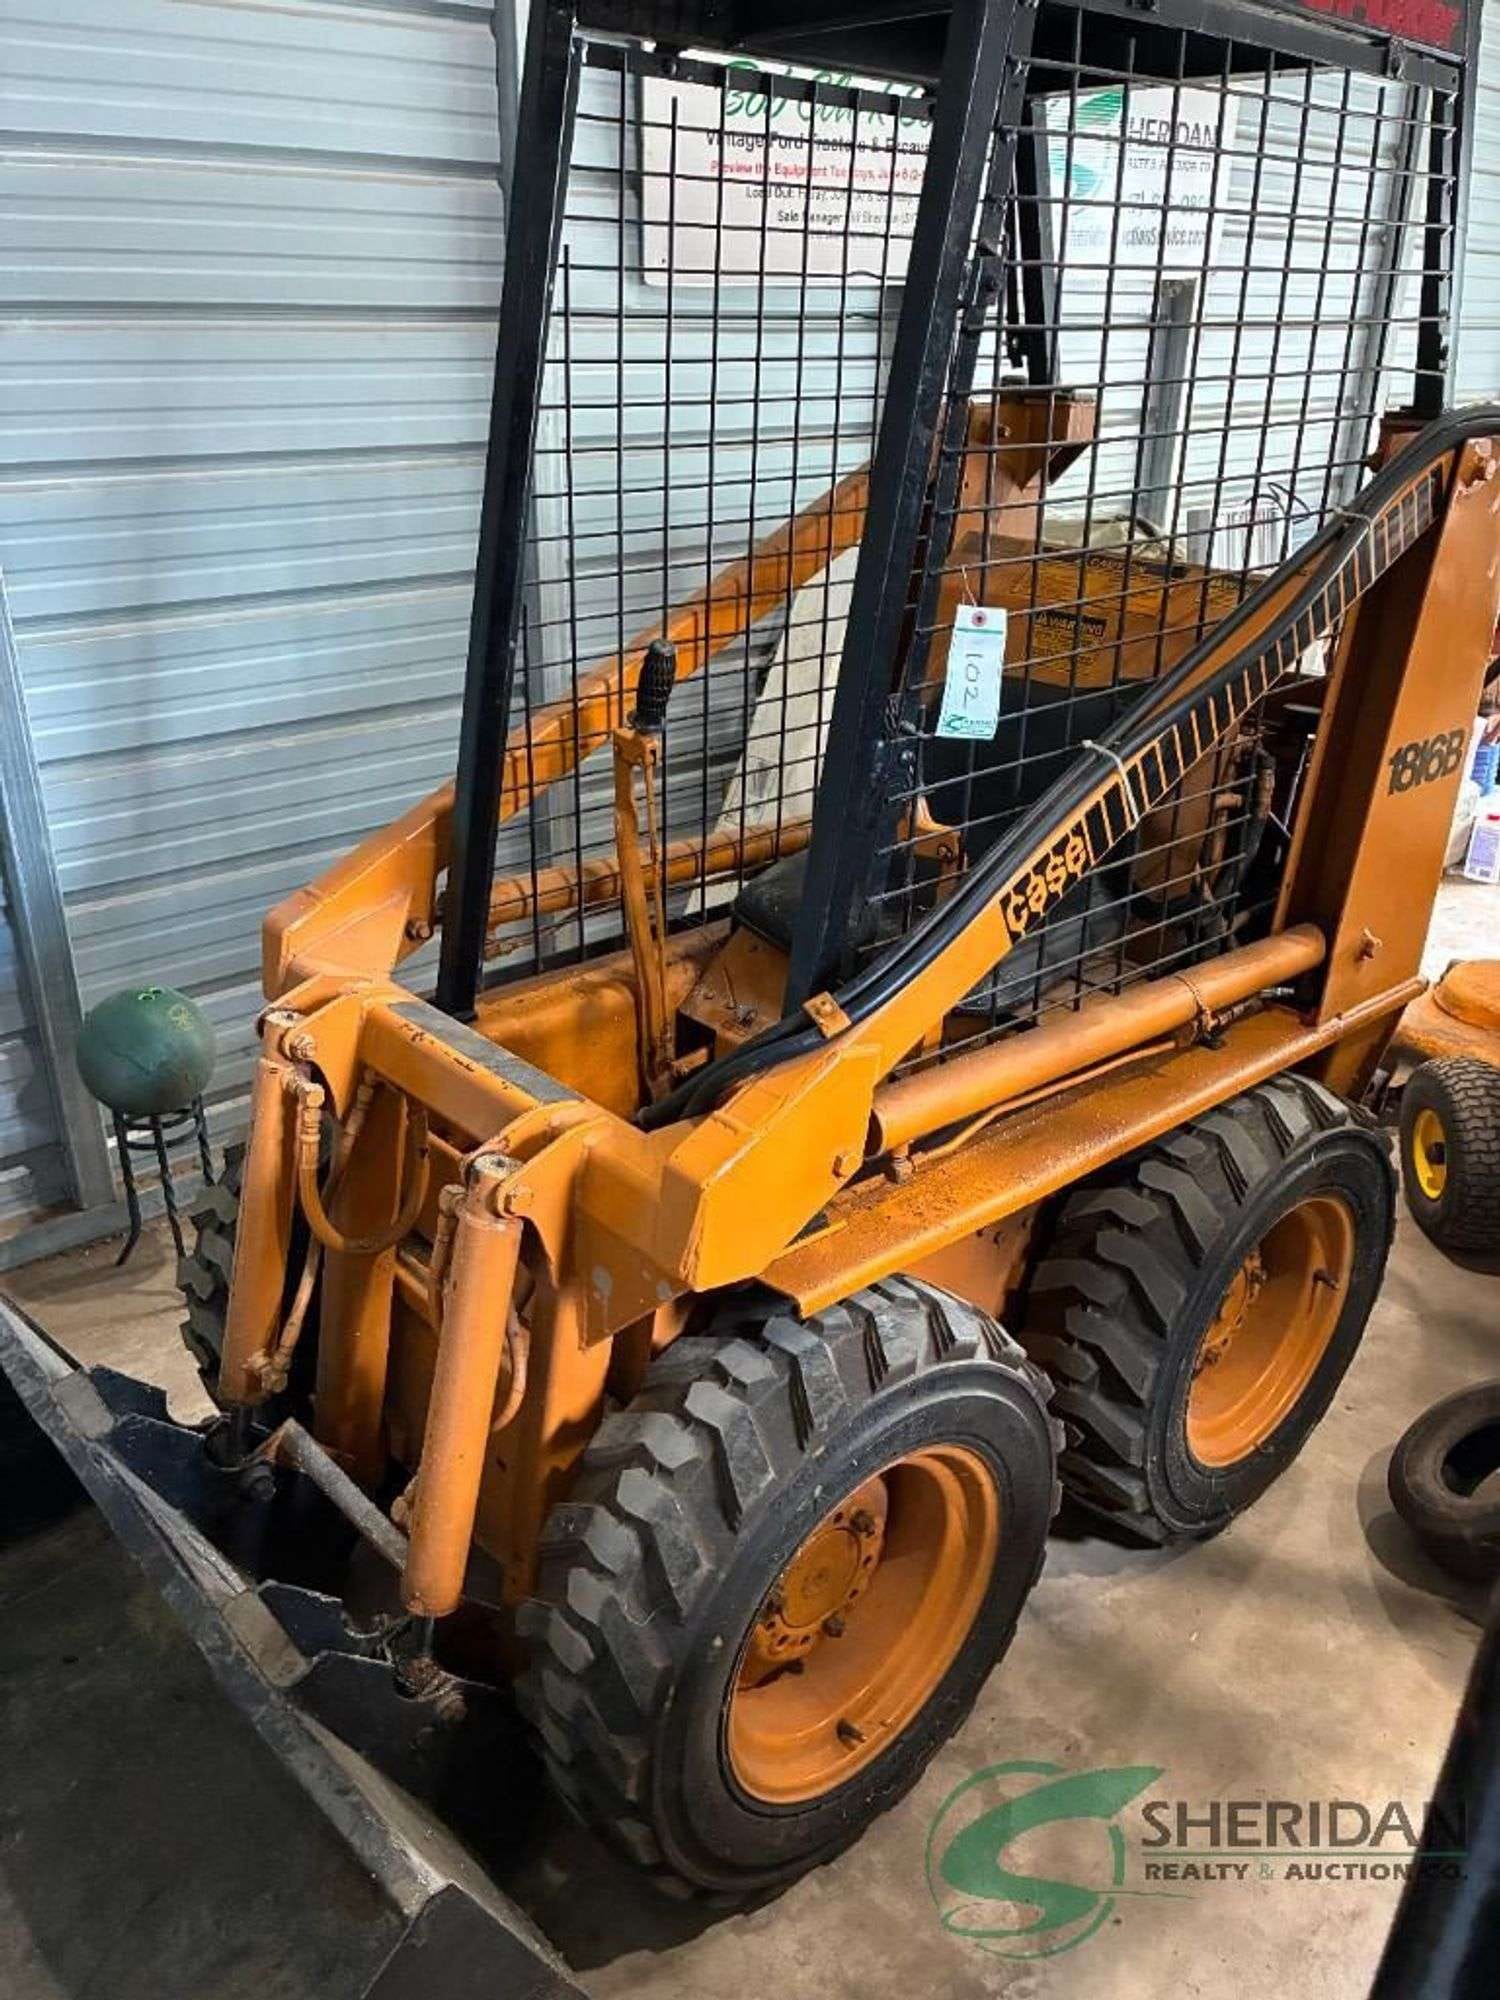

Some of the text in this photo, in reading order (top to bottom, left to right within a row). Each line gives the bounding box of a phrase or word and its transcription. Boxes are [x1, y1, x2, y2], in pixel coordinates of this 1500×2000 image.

[1119, 117, 1218, 146] HERDAN
[965, 652, 983, 710] 102
[1388, 729, 1466, 797] 1816B
